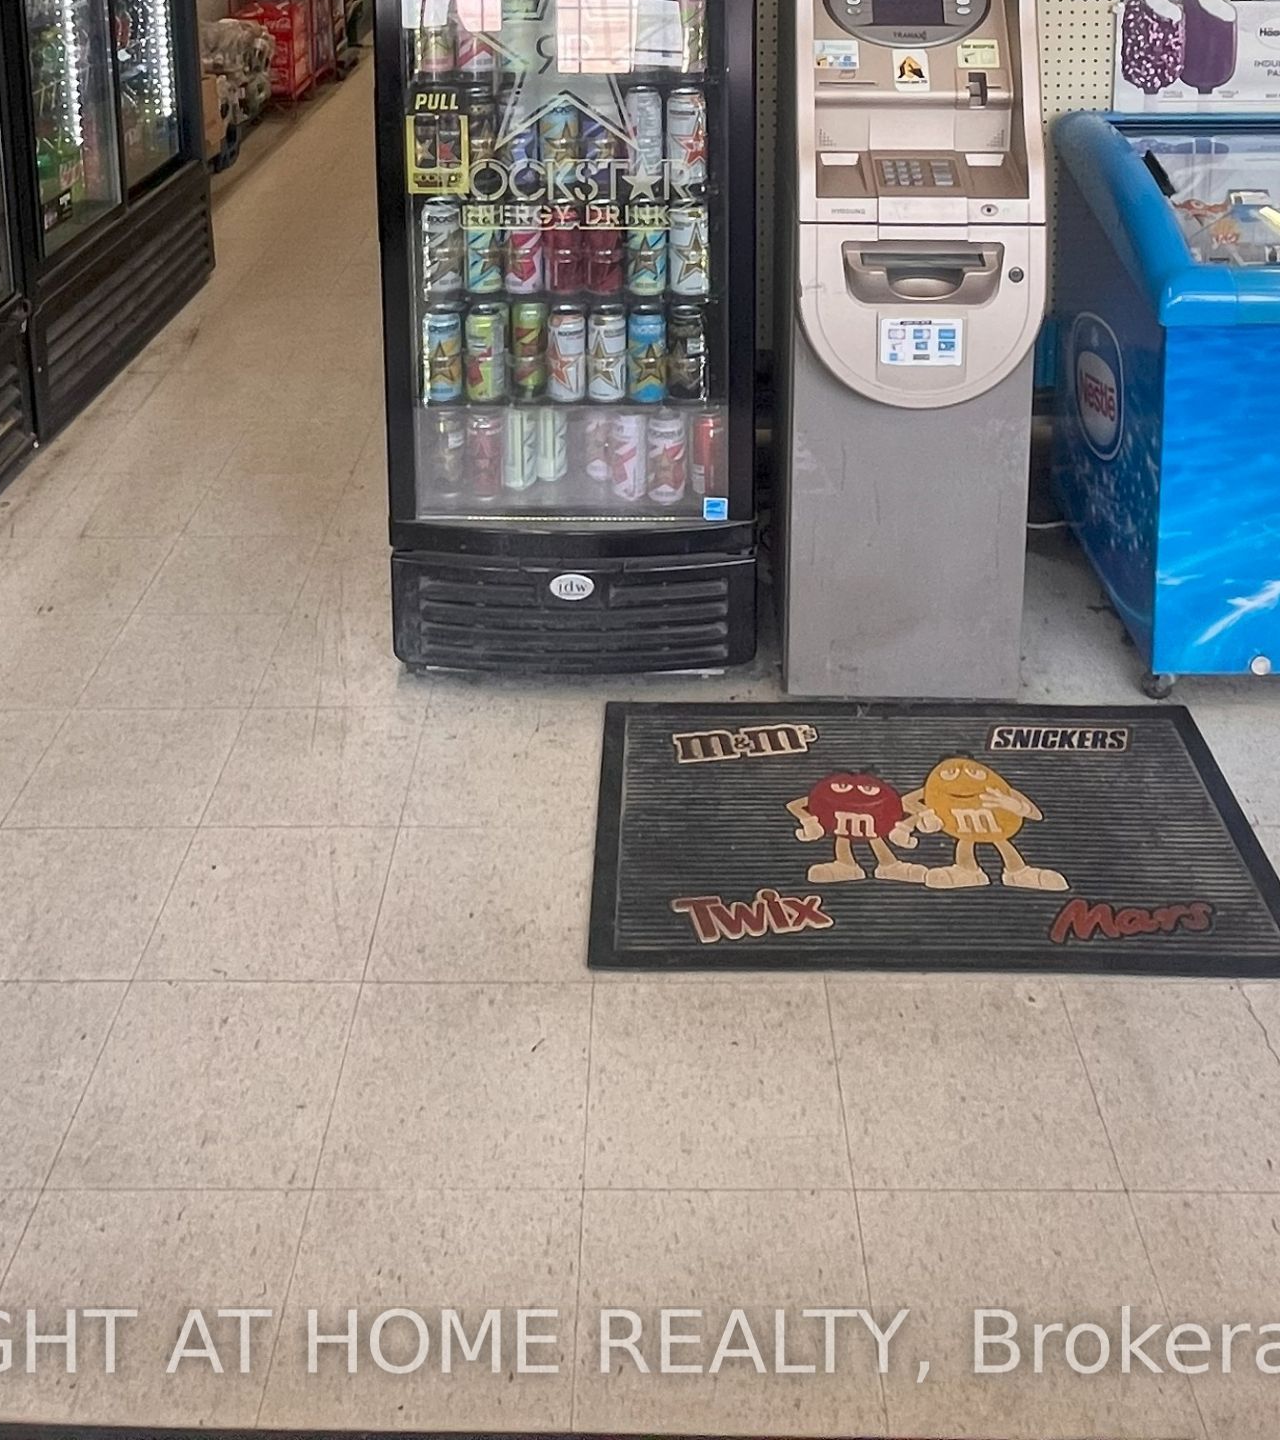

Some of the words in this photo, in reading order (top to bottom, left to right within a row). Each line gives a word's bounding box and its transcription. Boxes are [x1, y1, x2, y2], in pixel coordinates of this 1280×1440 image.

[414, 92, 460, 111] PULL
[462, 204, 571, 226] ENERGY
[585, 204, 671, 226] DRINK
[992, 727, 1128, 751] SNICKERS
[834, 810, 877, 839] m
[955, 807, 1001, 835] m
[676, 889, 834, 943] Twix
[1050, 898, 1213, 943] Mars
